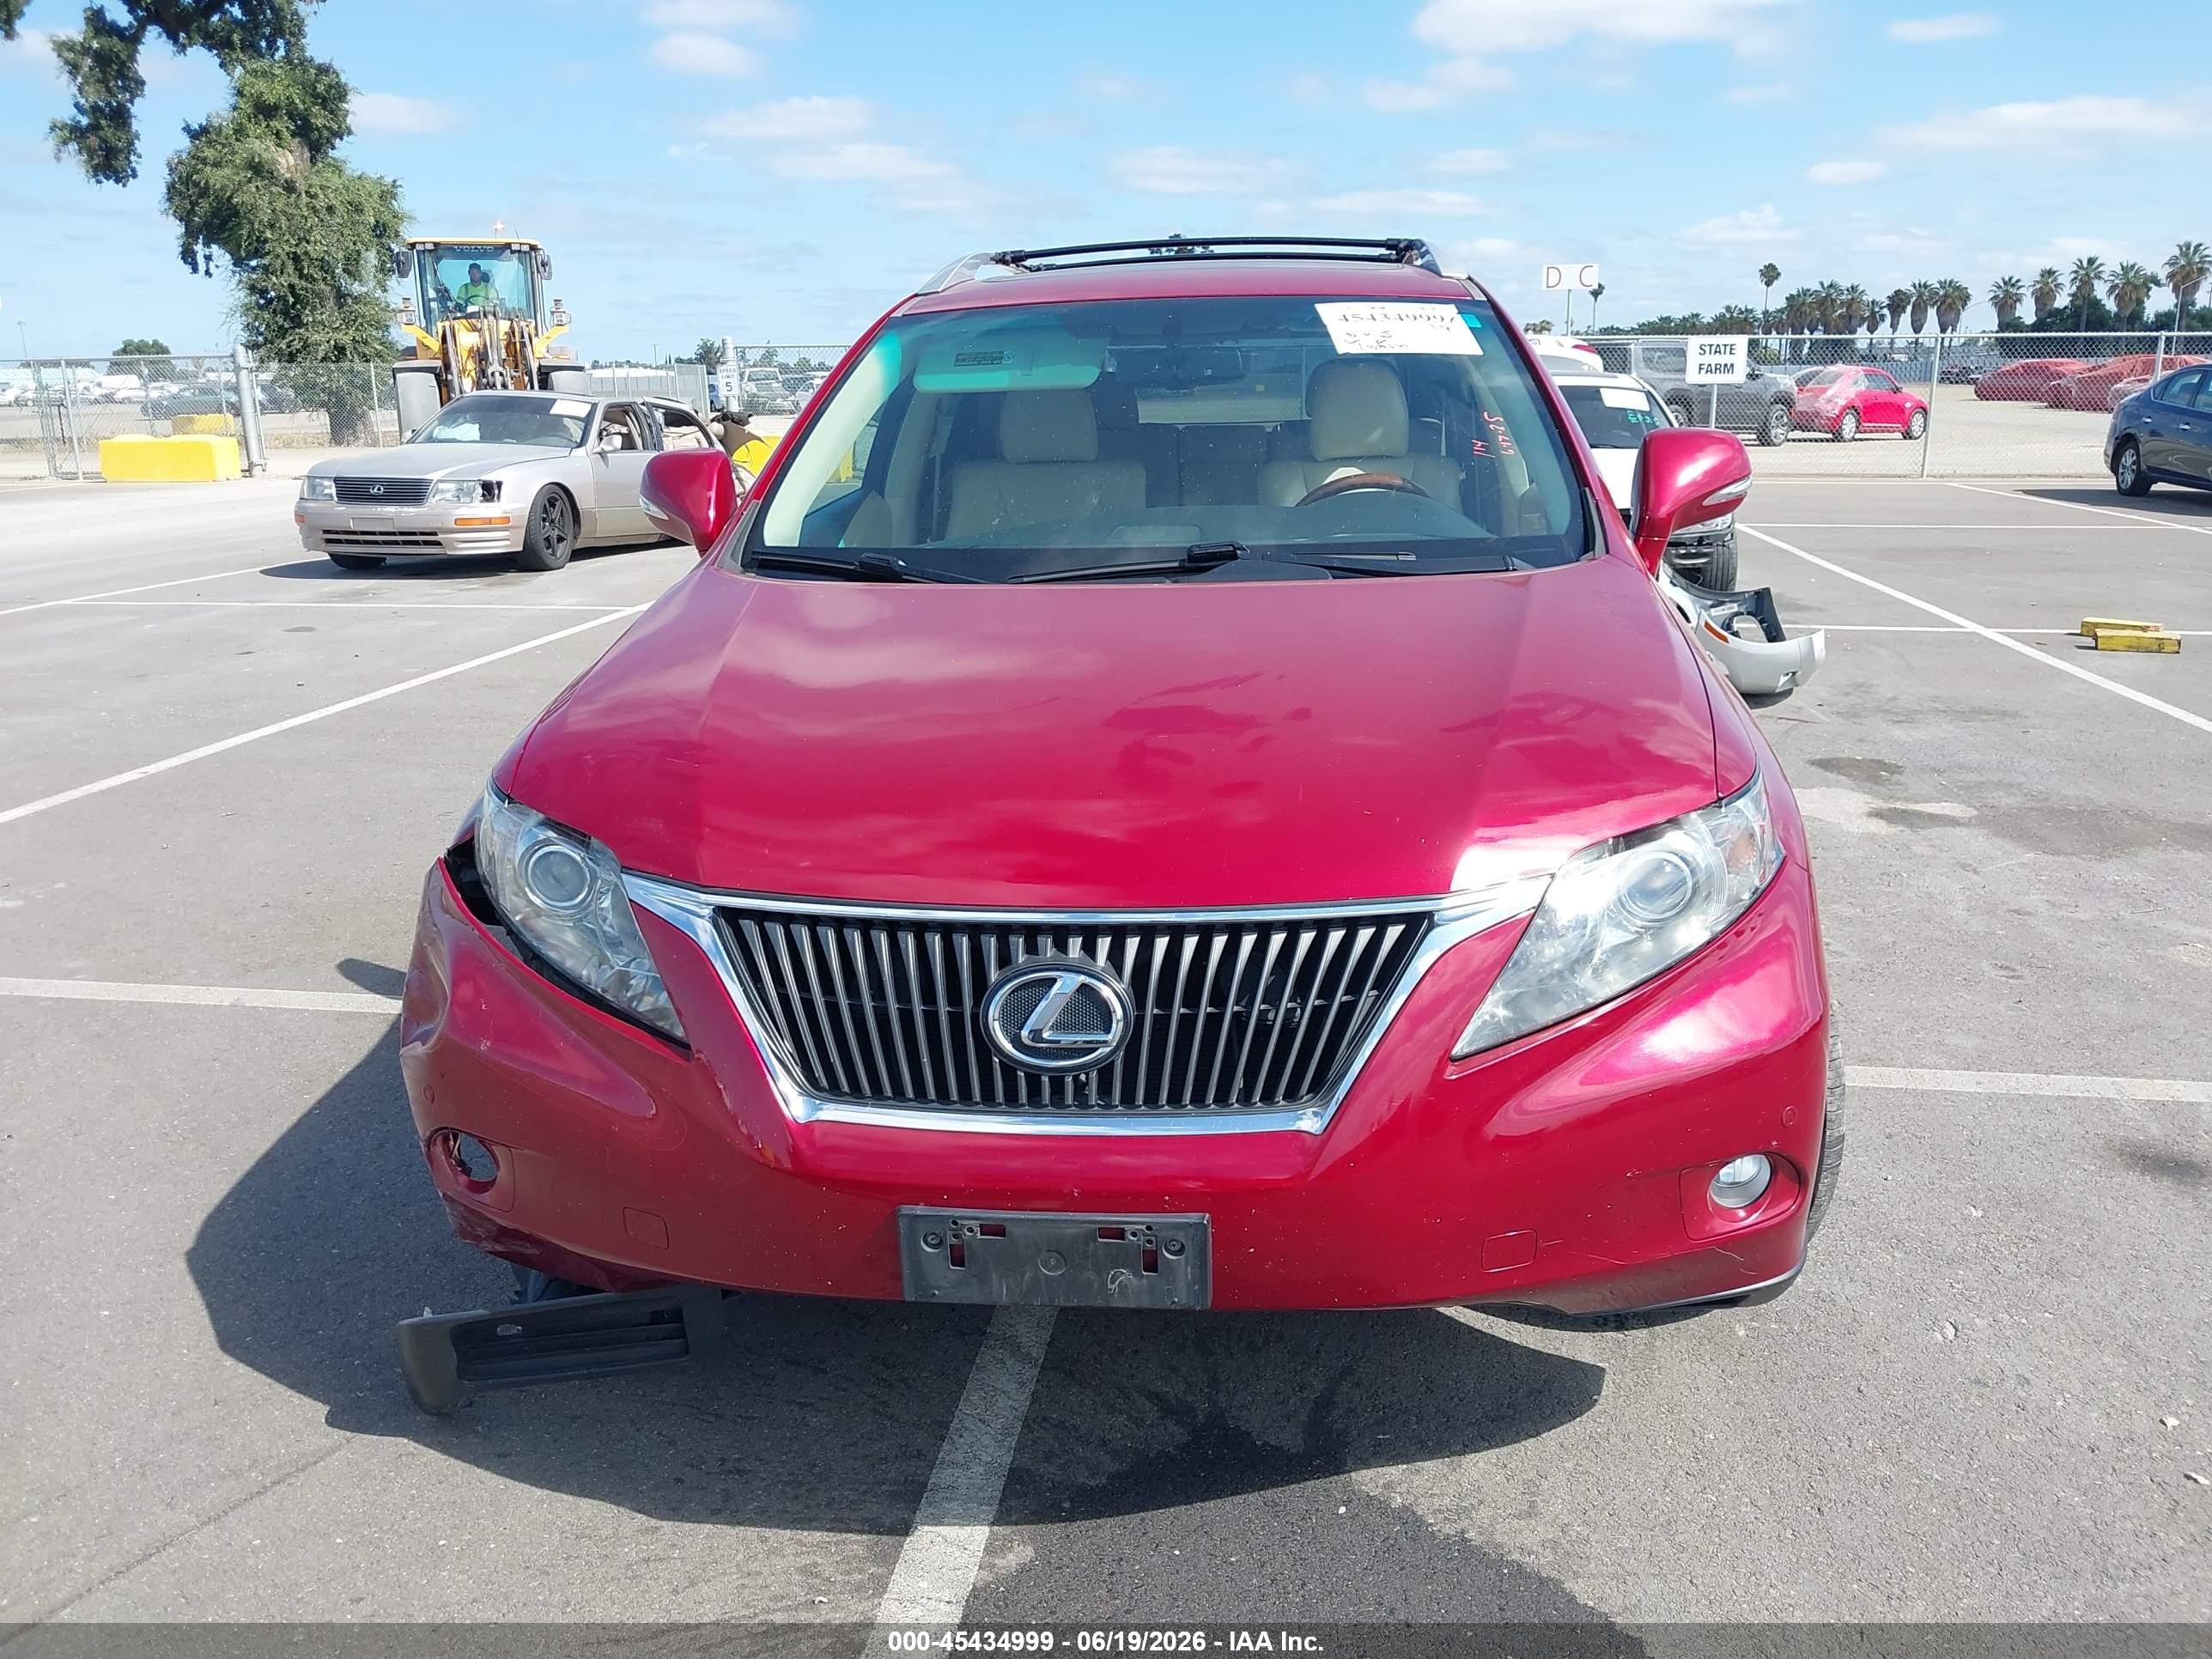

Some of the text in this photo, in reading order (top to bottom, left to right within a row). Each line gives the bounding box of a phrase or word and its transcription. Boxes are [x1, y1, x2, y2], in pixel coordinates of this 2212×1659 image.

[1546, 265, 1594, 289] D C
[1698, 343, 1737, 356] STATE
[1698, 362, 1735, 375] FARM
[725, 381, 733, 392] 5
